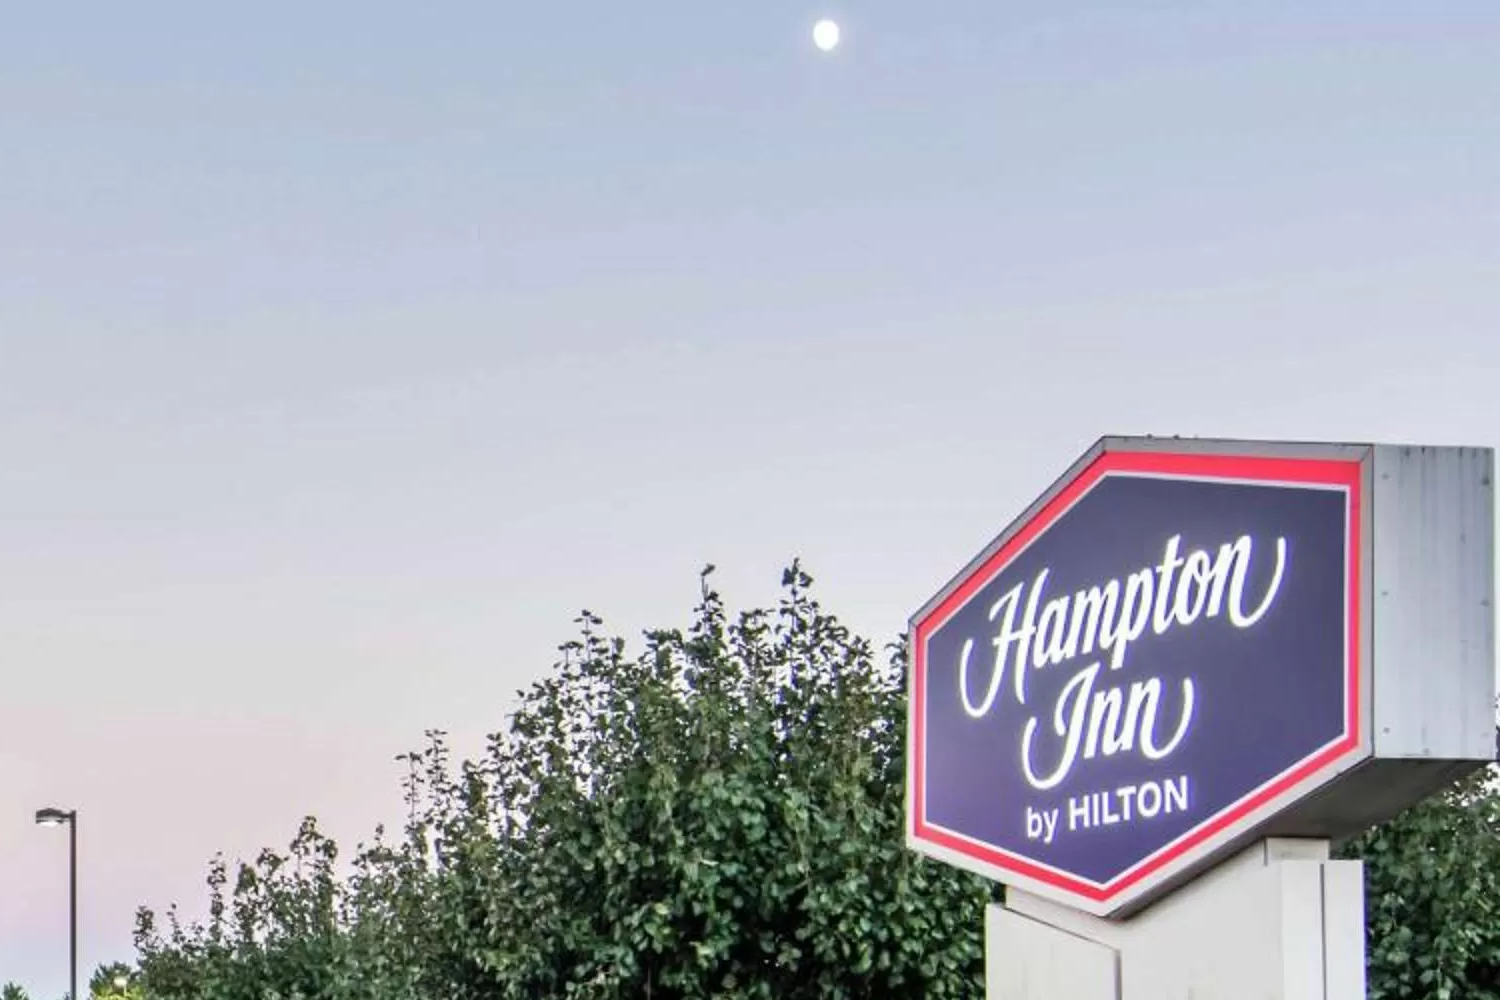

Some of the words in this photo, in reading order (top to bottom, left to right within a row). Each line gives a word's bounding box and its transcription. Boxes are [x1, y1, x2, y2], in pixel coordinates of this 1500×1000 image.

[961, 533, 1286, 718] Hampton
[1022, 662, 1194, 790] Inn
[1026, 807, 1059, 843] by
[1067, 776, 1189, 830] HILTON
